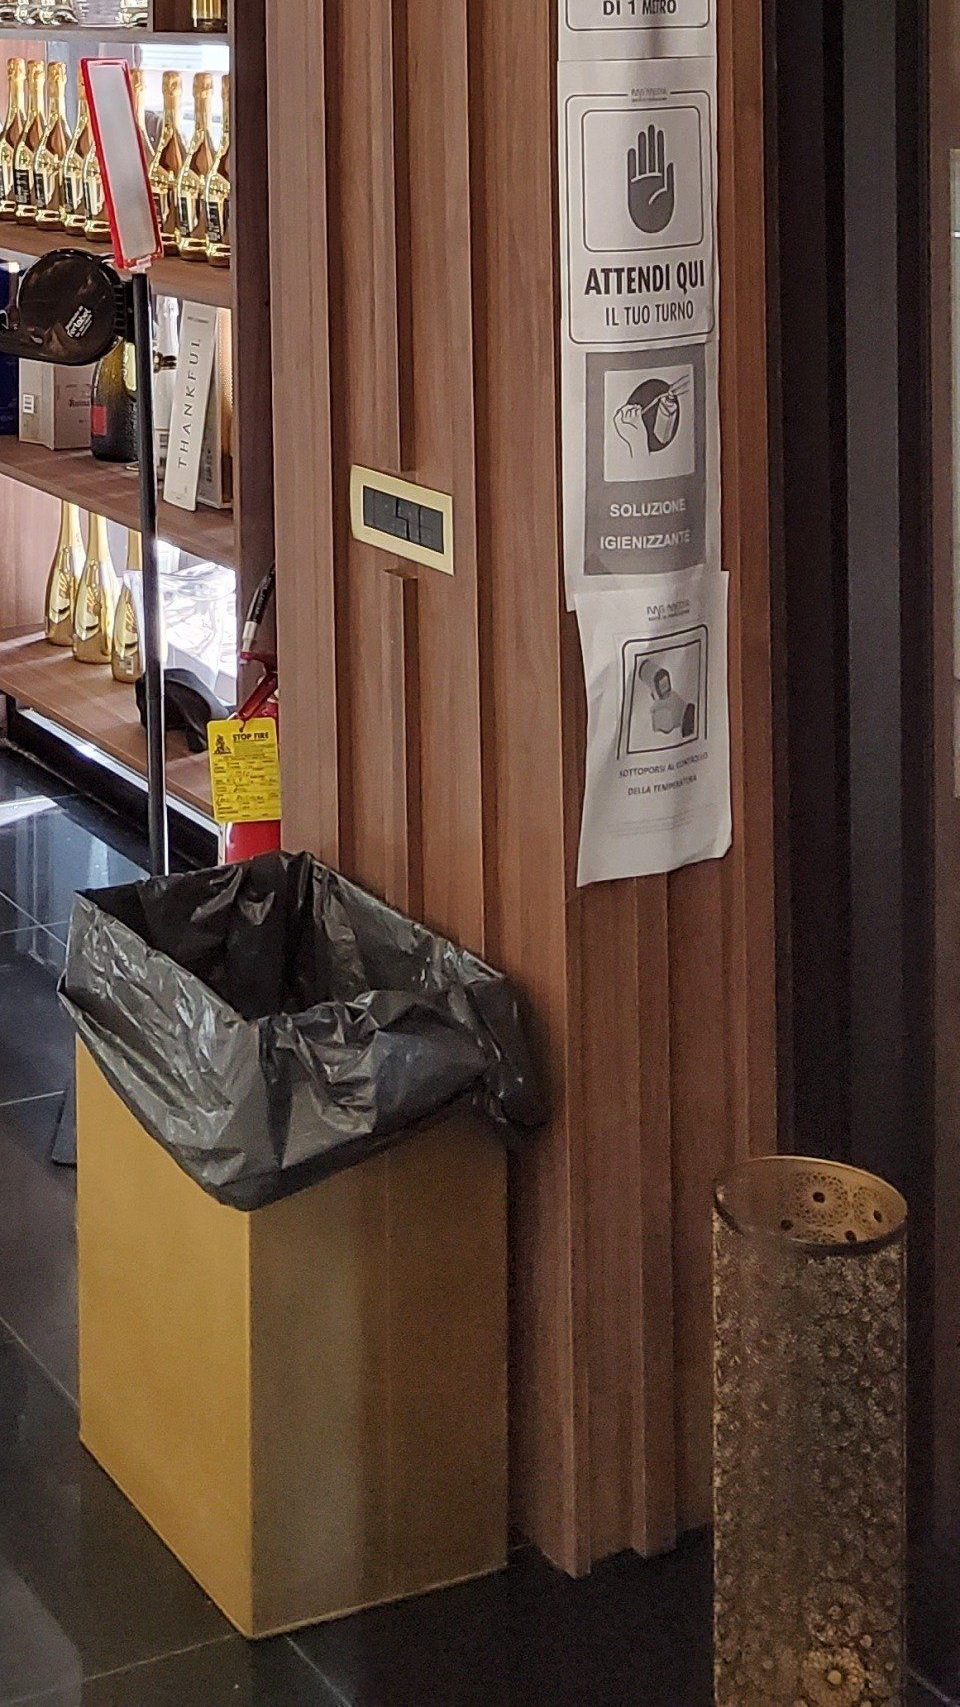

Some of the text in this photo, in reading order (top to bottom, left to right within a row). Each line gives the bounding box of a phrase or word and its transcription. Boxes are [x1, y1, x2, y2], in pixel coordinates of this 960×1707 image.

[603, 0, 621, 16] DI
[628, 0, 635, 15] 1
[584, 259, 705, 296] ATTENDI QUI
[605, 300, 694, 326] IL TUO TURNO
[177, 339, 201, 469] THANKFUL
[609, 498, 687, 518] SOLUZIONE
[600, 529, 691, 550] IGIENIZZANTE
[232, 733, 251, 742] STOP
[253, 732, 269, 740] FIRE
[627, 786, 651, 796] DELLA
